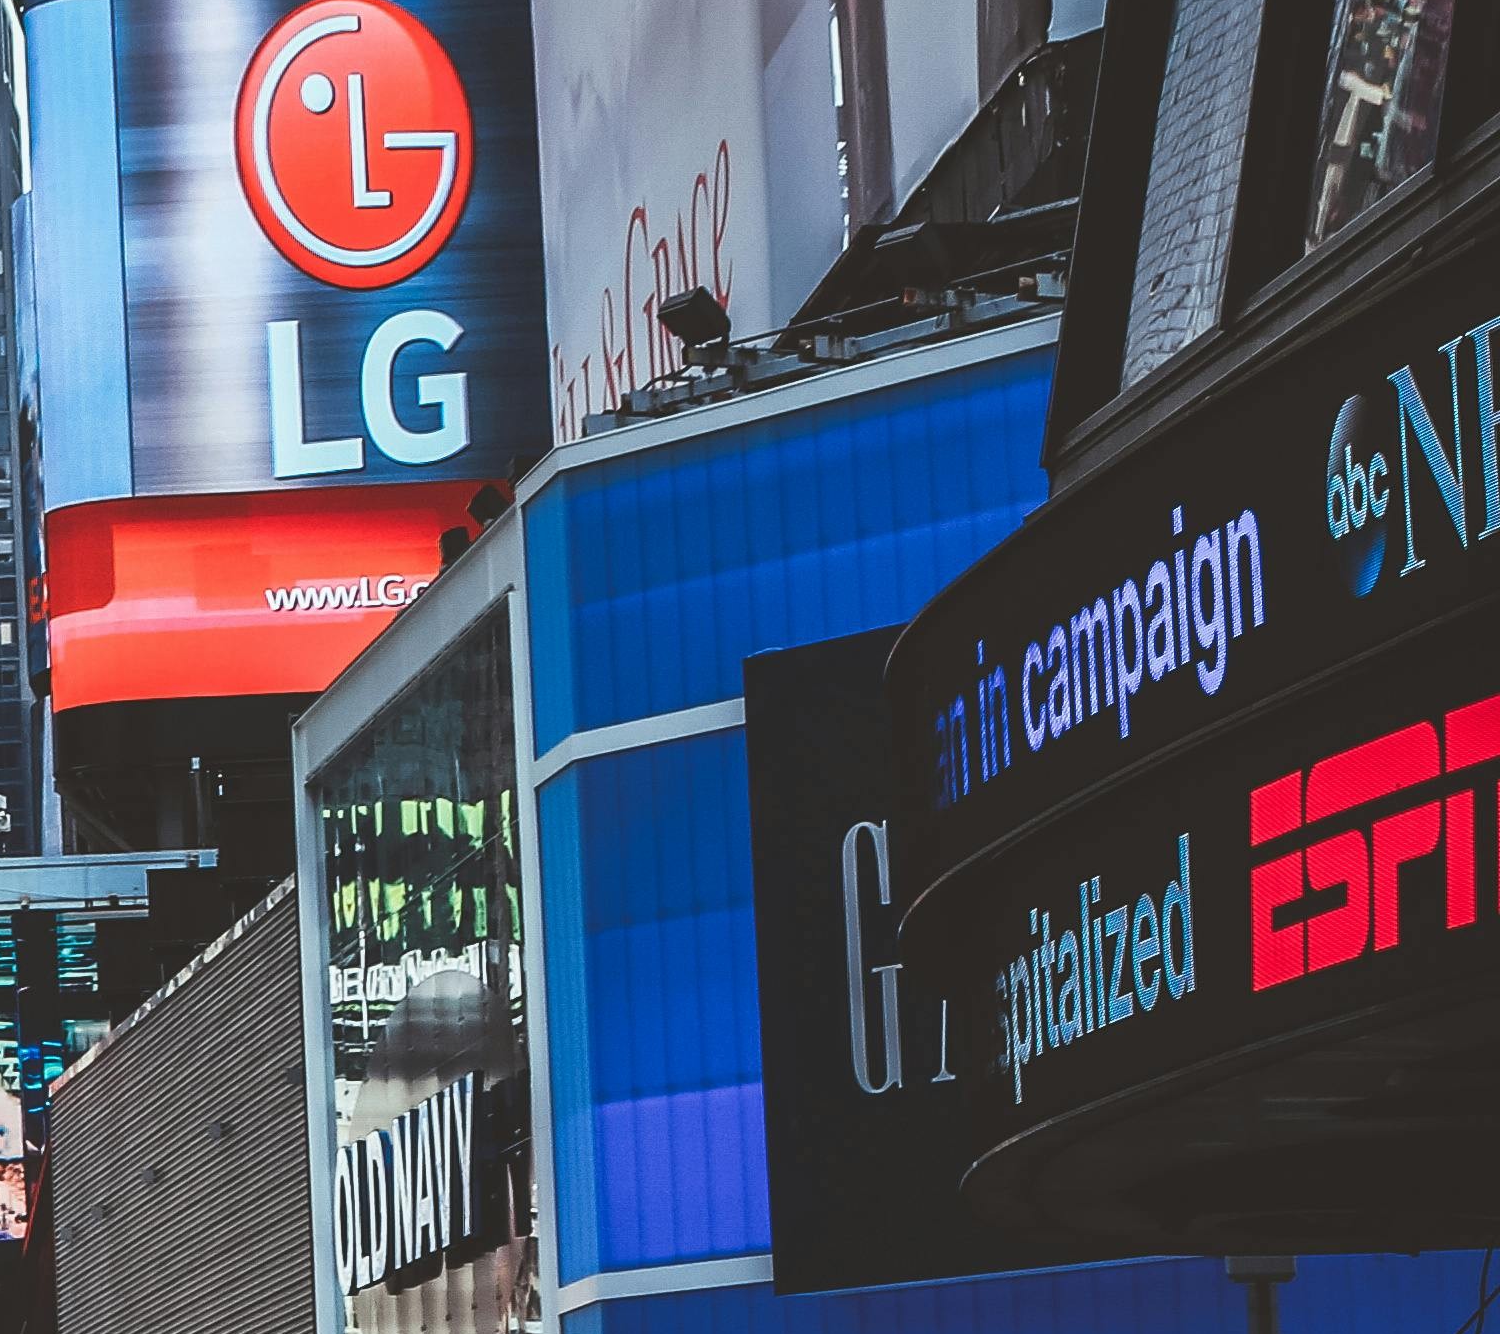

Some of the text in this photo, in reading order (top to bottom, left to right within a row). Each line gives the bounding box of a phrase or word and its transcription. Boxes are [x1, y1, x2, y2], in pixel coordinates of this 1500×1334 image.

[266, 309, 470, 480] LG
[1327, 443, 1391, 540] abc
[977, 504, 1264, 784] in campaign
[335, 1070, 475, 1296] OLD NAVY
